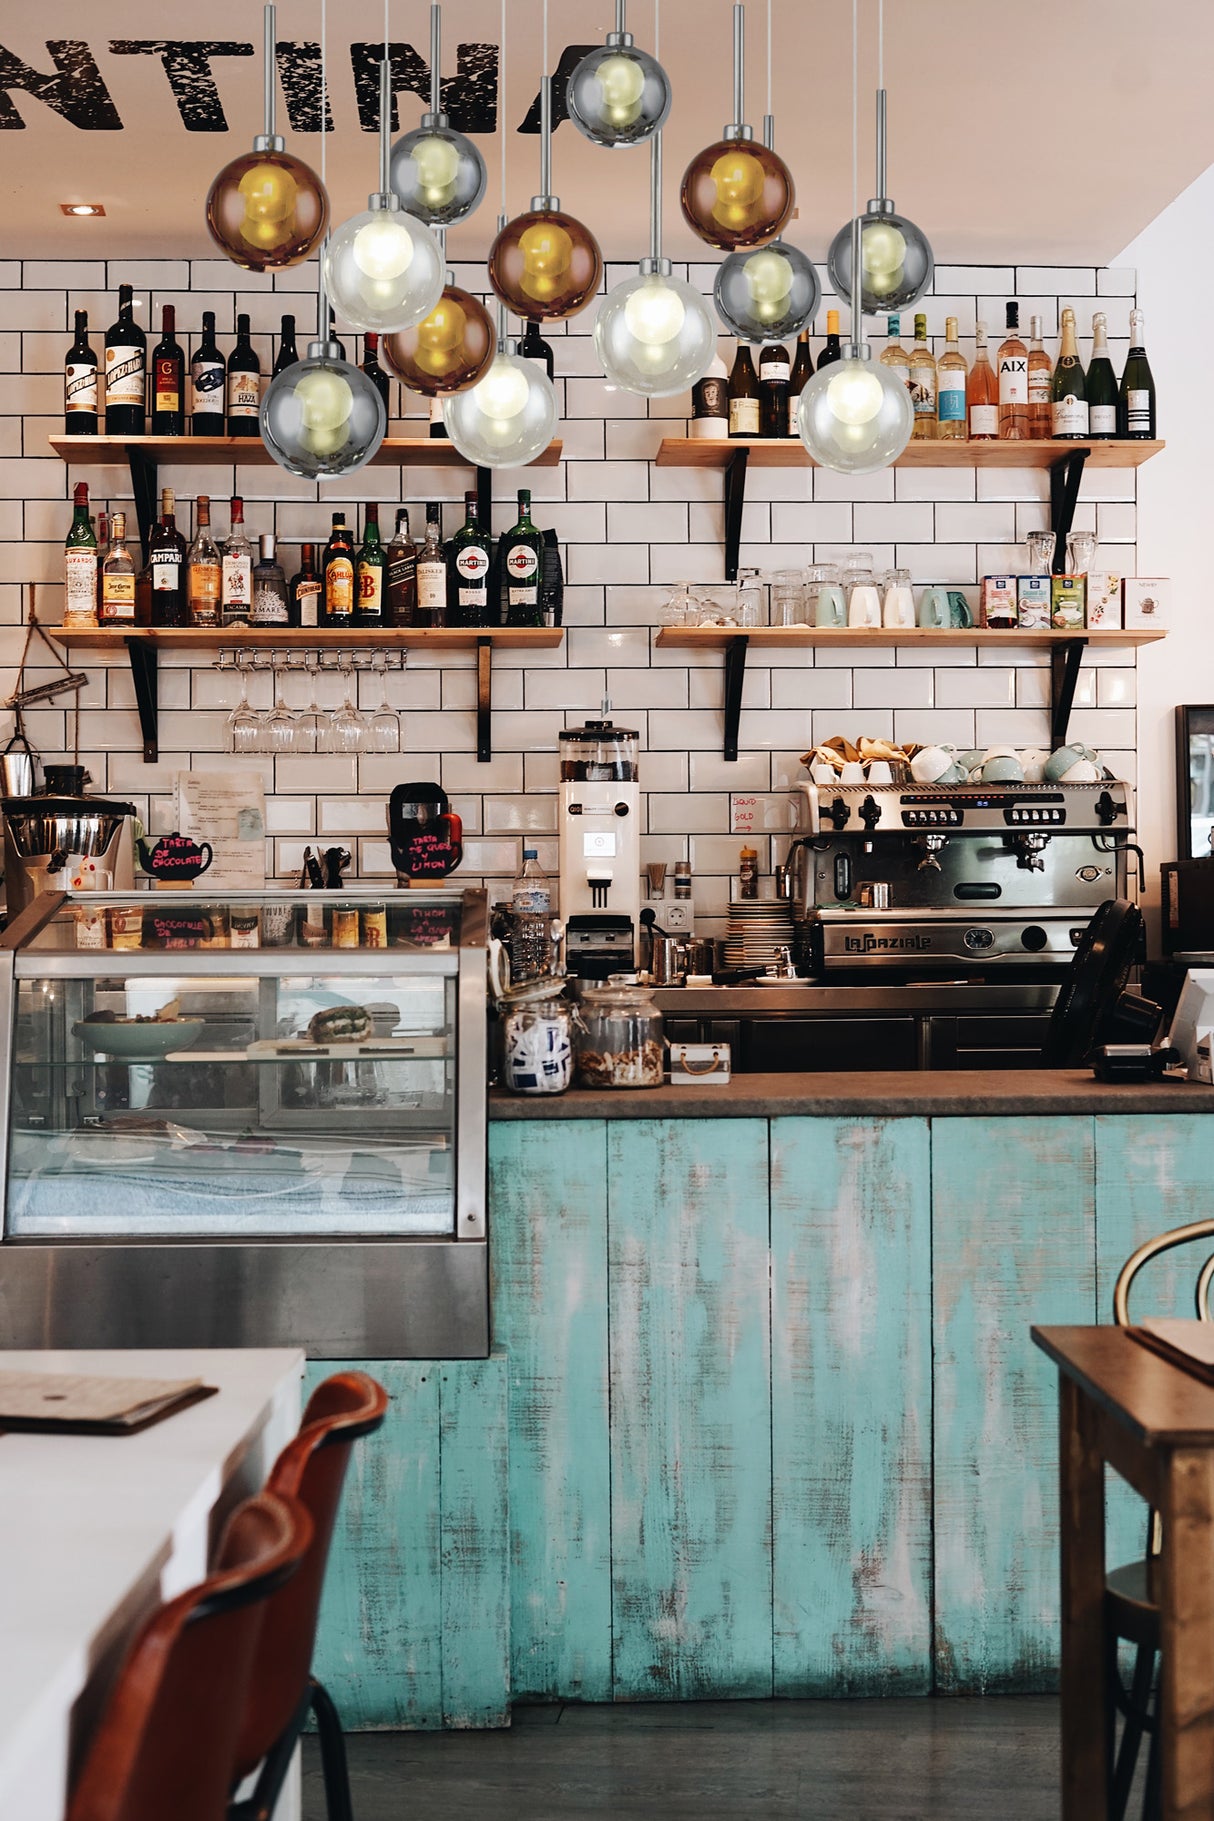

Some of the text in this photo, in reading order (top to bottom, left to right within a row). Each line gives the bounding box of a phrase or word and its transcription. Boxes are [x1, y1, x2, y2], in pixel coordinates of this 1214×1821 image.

[1000, 360, 1026, 373] AIX
[151, 553, 183, 564] CAMPARI
[509, 557, 536, 565] MARTINI
[734, 812, 754, 821] GOLD
[162, 837, 193, 848] TARTA
[412, 835, 438, 845] TARTA
[155, 849, 170, 858] DE
[421, 852, 429, 861] Y
[152, 855, 203, 868] CHOCOLATE
[411, 860, 446, 872] LIMON
